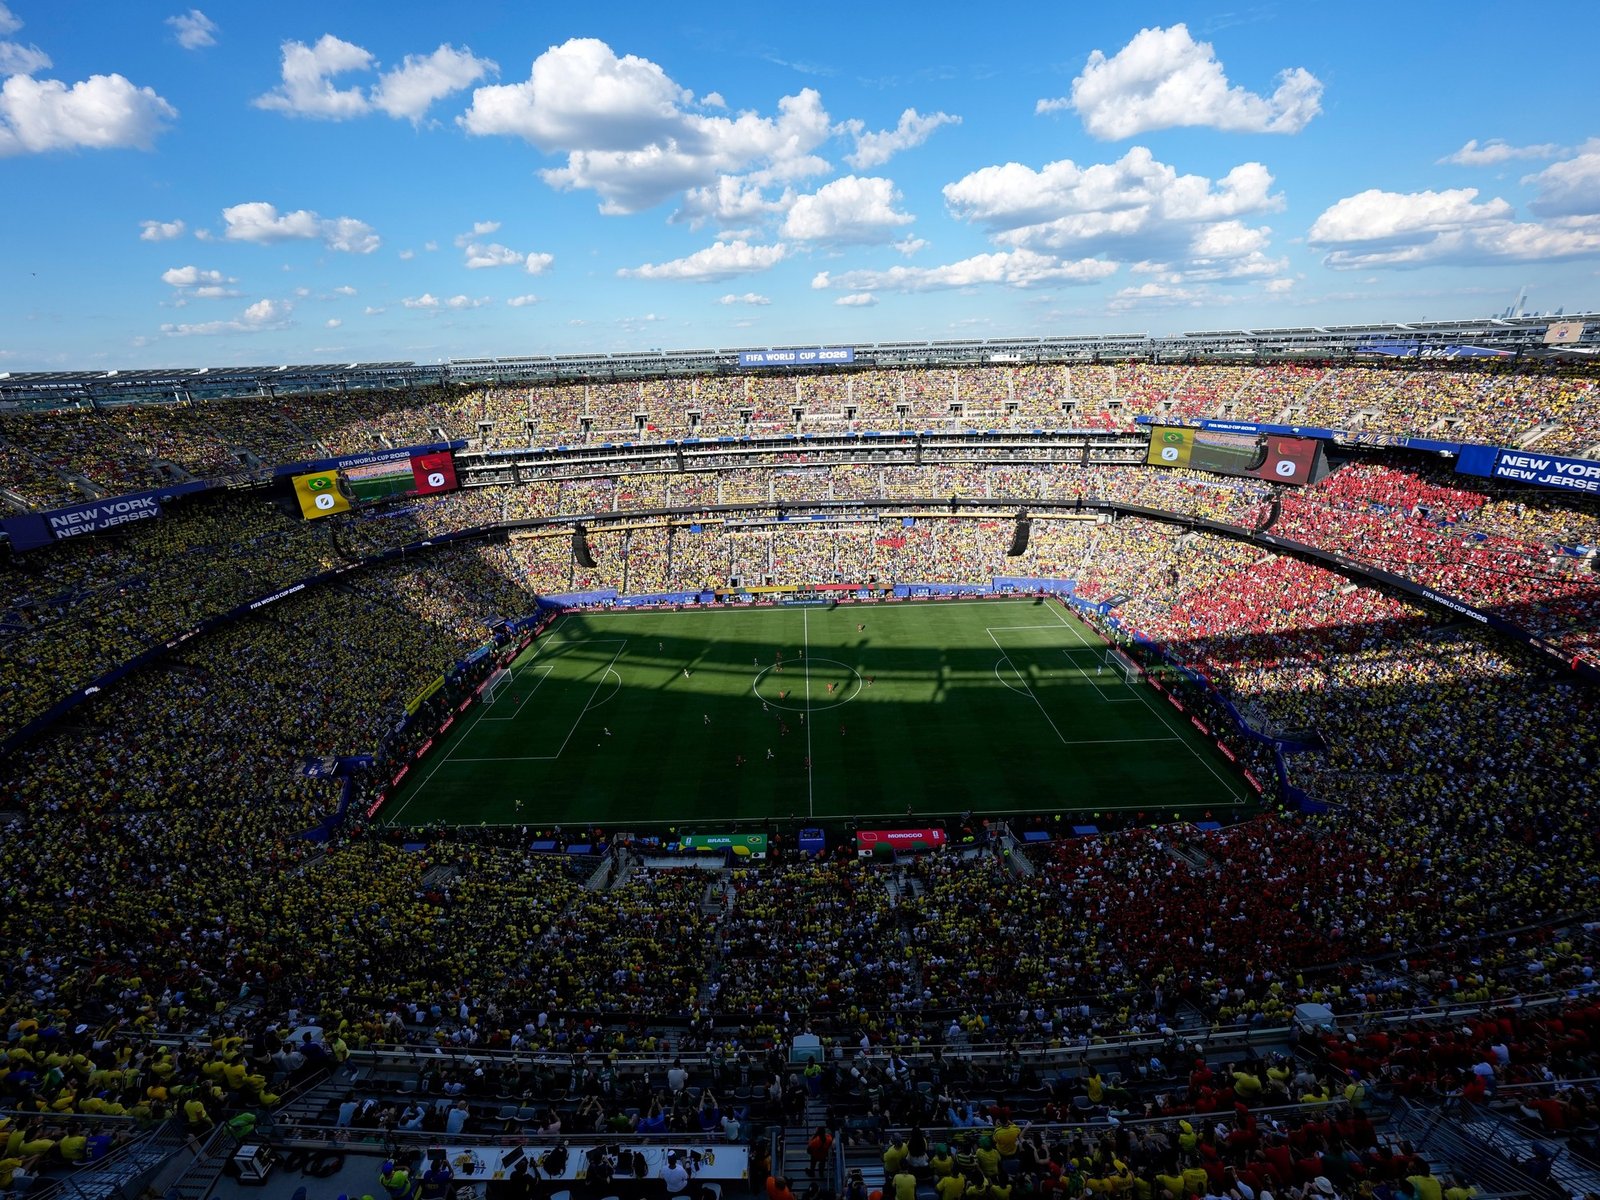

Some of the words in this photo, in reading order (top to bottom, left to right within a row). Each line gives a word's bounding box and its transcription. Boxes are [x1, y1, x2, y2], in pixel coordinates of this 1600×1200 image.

[353, 456, 377, 465] WORLD
[377, 454, 390, 462] CUP
[390, 451, 410, 459] 2026
[1501, 454, 1550, 470] NEW
[1554, 462, 1600, 479] YOR
[1498, 467, 1536, 480] NEW
[1538, 474, 1599, 491] JERSE
[50, 508, 98, 527] NEW
[101, 496, 155, 515] YORK
[56, 522, 94, 539] NEW
[99, 508, 158, 528] JERSEY
[261, 594, 280, 605] WORLD
[289, 584, 305, 594] 2026
[1422, 590, 1434, 599] FIFA
[1434, 595, 1454, 608] WORLD
[1454, 604, 1466, 612] CUP
[1466, 610, 1488, 623] 2026
[1192, 716, 1208, 735] Lenovo
[1218, 740, 1234, 761] Lenovo
[393, 766, 408, 786] Lenovo
[1244, 769, 1261, 792] Lenovo
[368, 795, 384, 818] Lenovo
